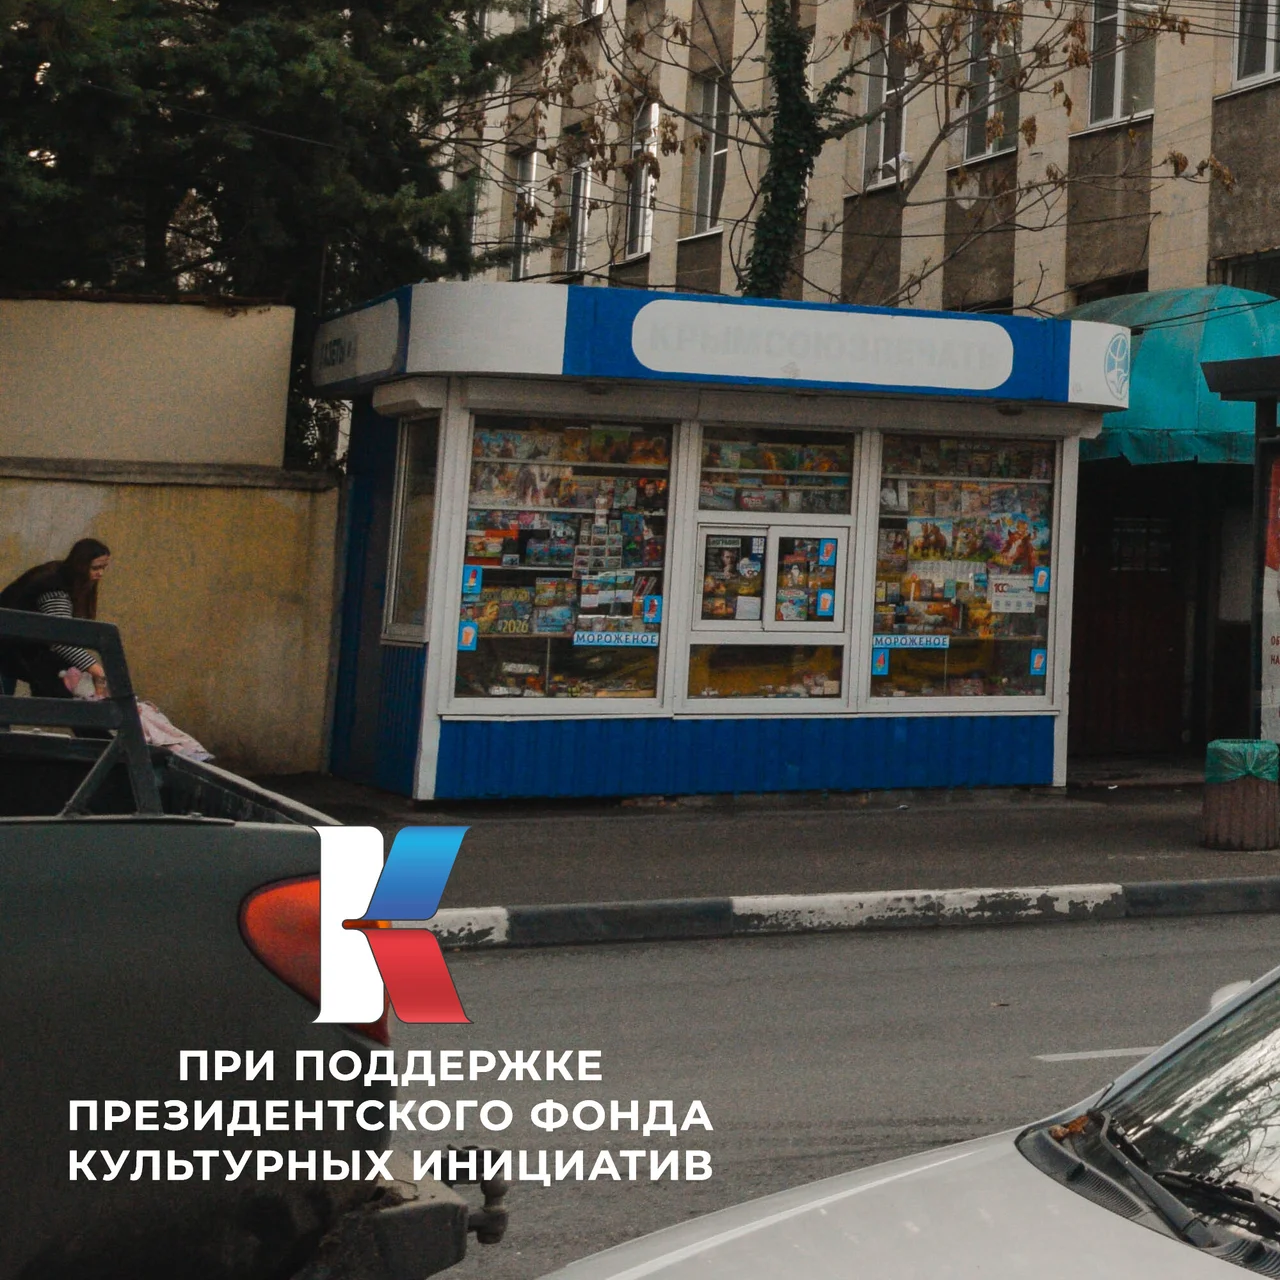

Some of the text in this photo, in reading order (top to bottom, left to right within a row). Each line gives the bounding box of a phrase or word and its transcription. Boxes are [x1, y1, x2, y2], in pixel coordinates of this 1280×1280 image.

[502, 619, 529, 633] 2026
[575, 633, 657, 645] МОРОЖЕНОЕ
[874, 636, 948, 647] МОРОЖЕНОЕ
